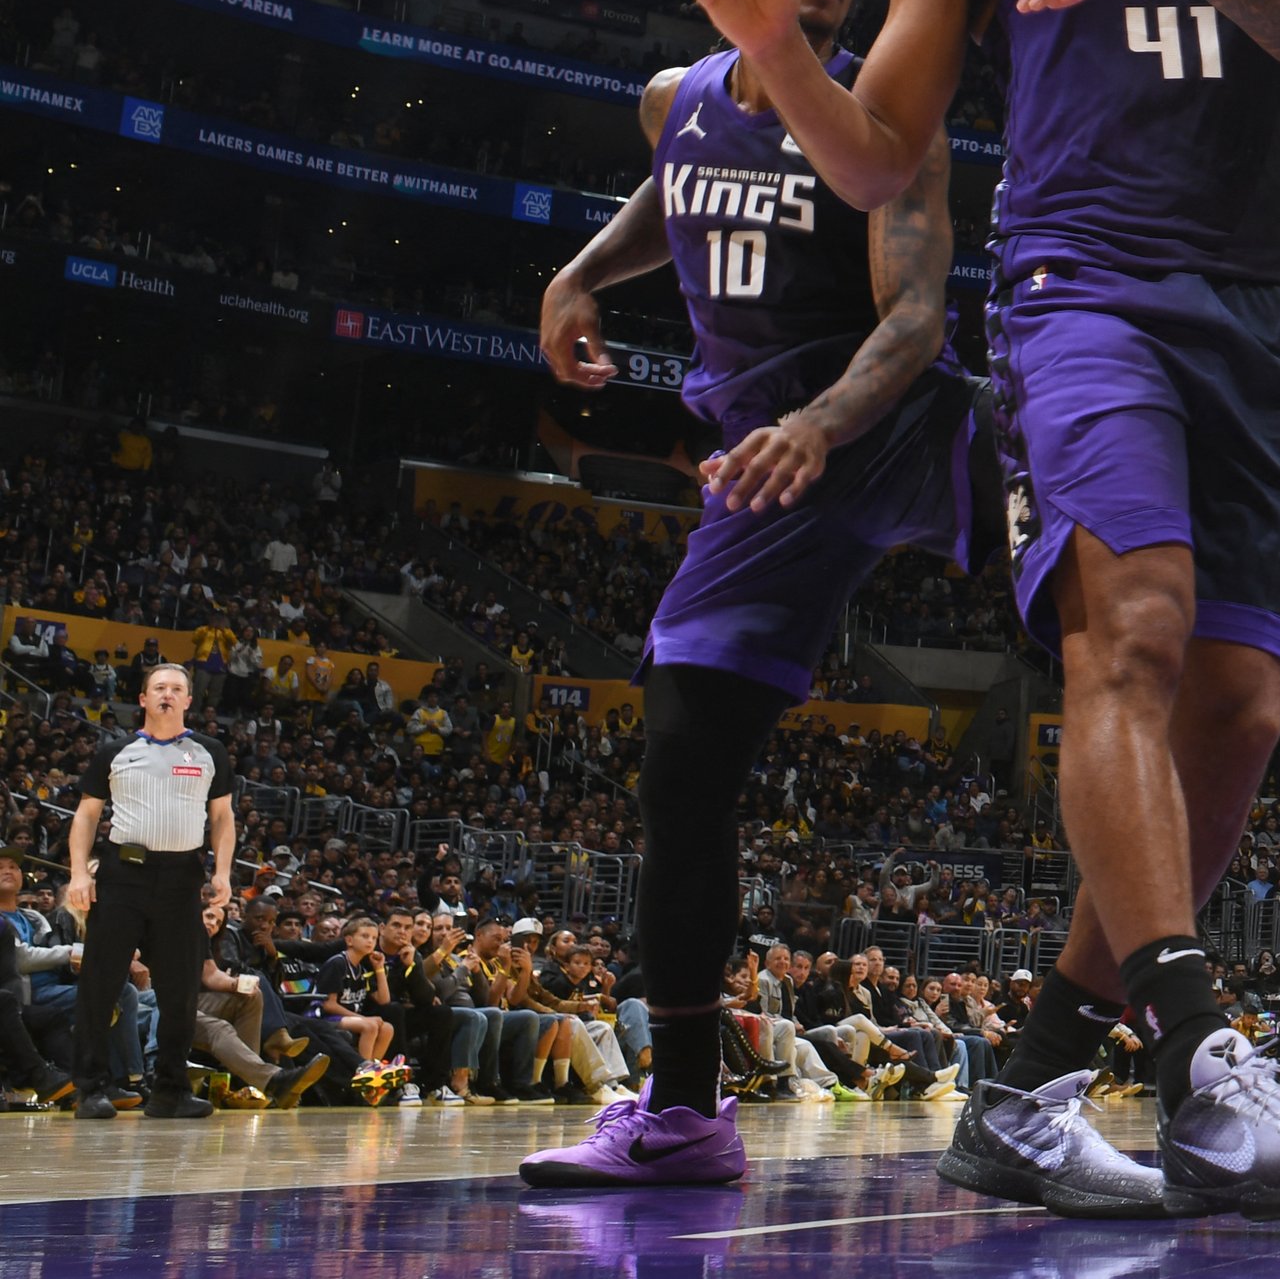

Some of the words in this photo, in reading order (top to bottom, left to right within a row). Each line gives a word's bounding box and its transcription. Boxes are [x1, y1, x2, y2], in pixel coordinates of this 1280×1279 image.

[603, 8, 641, 25] TOYOTA
[1125, 6, 1223, 79] 41
[362, 27, 414, 50] LEARN
[418, 39, 462, 60] MORE
[465, 50, 486, 64] AT
[488, 54, 644, 97] GO.AMEX/CRYPTO-AR
[0, 80, 84, 112] WITHAMEX
[198, 128, 253, 154] LAKERS
[256, 142, 303, 167] GAMES
[305, 155, 333, 173] ARE
[336, 162, 389, 185] BETTER
[392, 173, 478, 201] #WITHAMEX
[697, 166, 781, 183] SACRAMENTO
[71, 262, 110, 282] UCLA
[121, 271, 176, 297] Health
[706, 229, 767, 300] 10
[219, 293, 309, 323] uclahealth.org
[549, 688, 582, 707] 114
